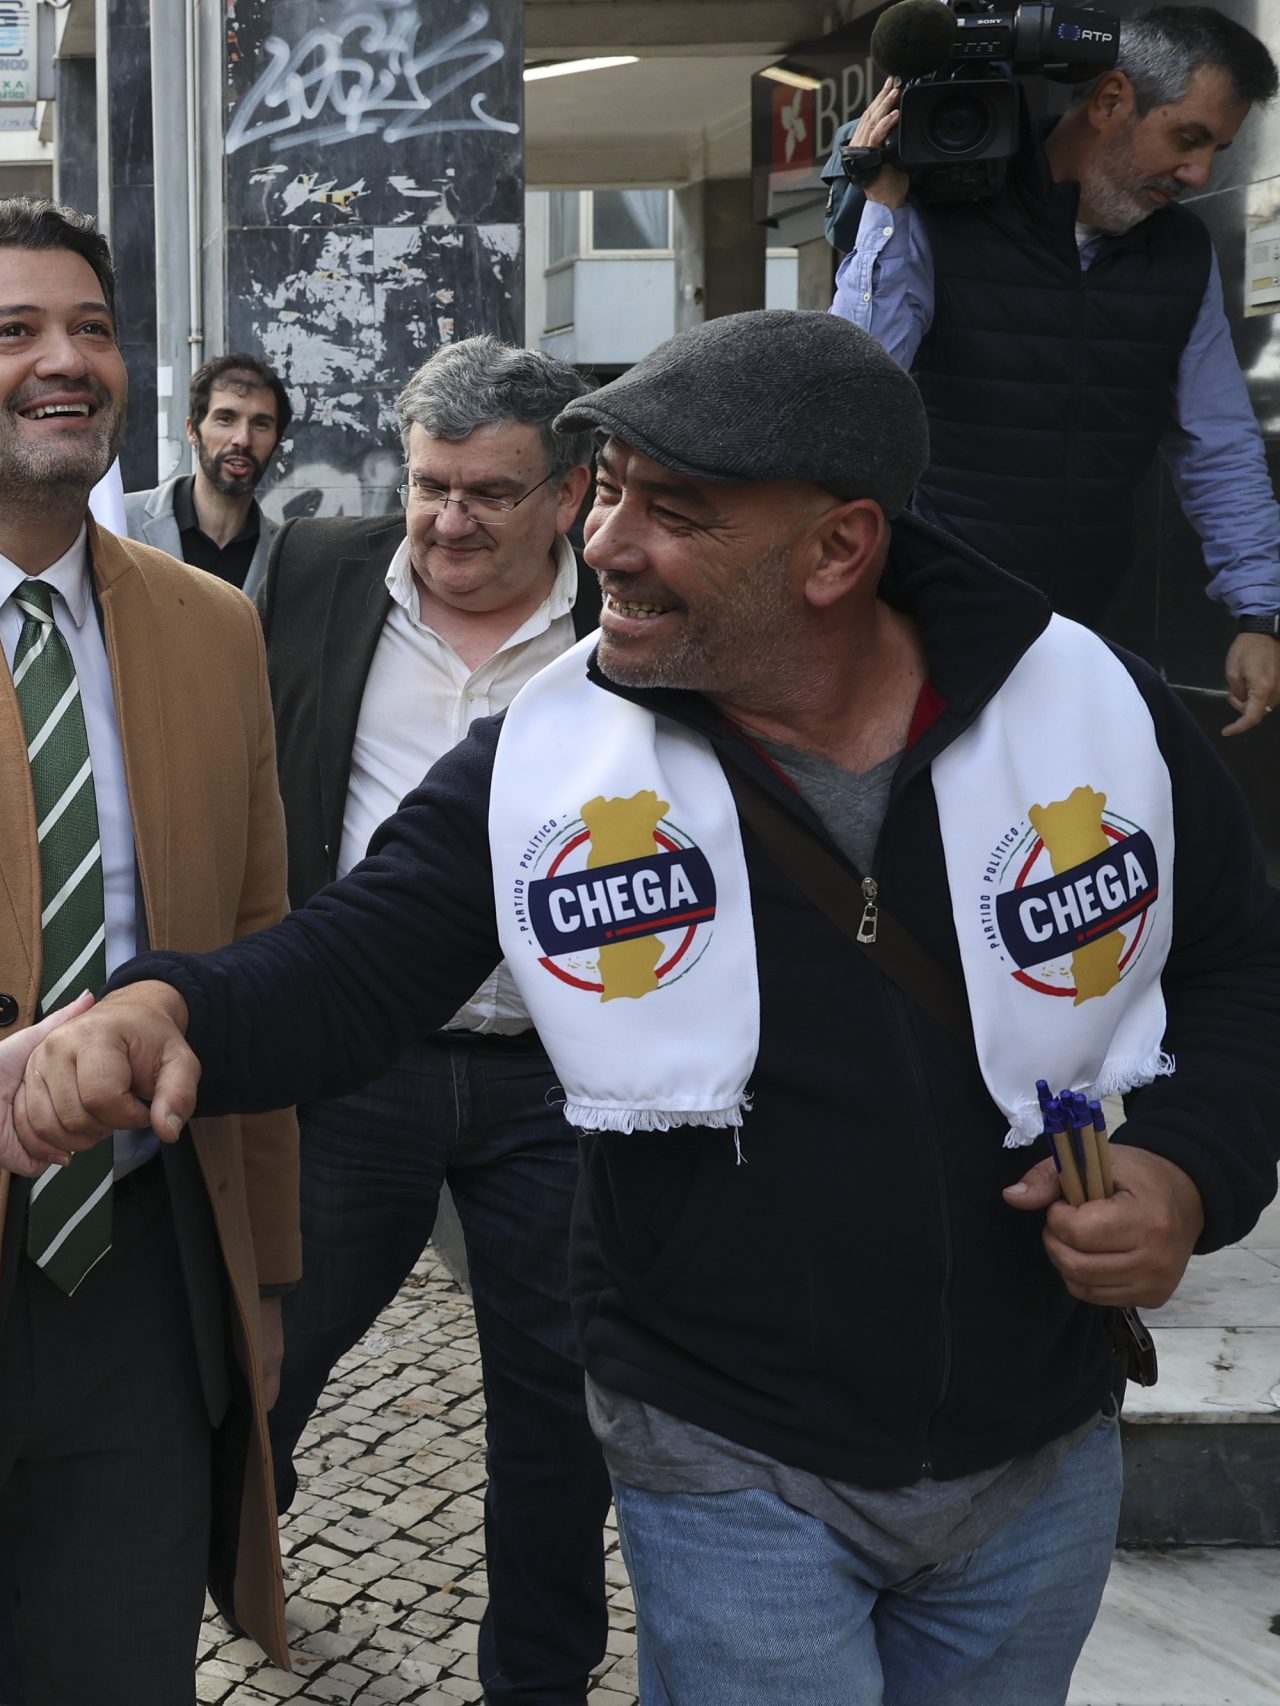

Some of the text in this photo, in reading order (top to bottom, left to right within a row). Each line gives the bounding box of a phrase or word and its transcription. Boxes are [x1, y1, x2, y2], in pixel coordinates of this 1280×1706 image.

[1081, 29, 1113, 43] RTP
[815, 56, 875, 158] BPI
[514, 879, 529, 931] PARTIDO
[548, 863, 699, 933] CHEGA
[980, 895, 1000, 949] PARTIDO
[1018, 851, 1149, 943] CHEGA
